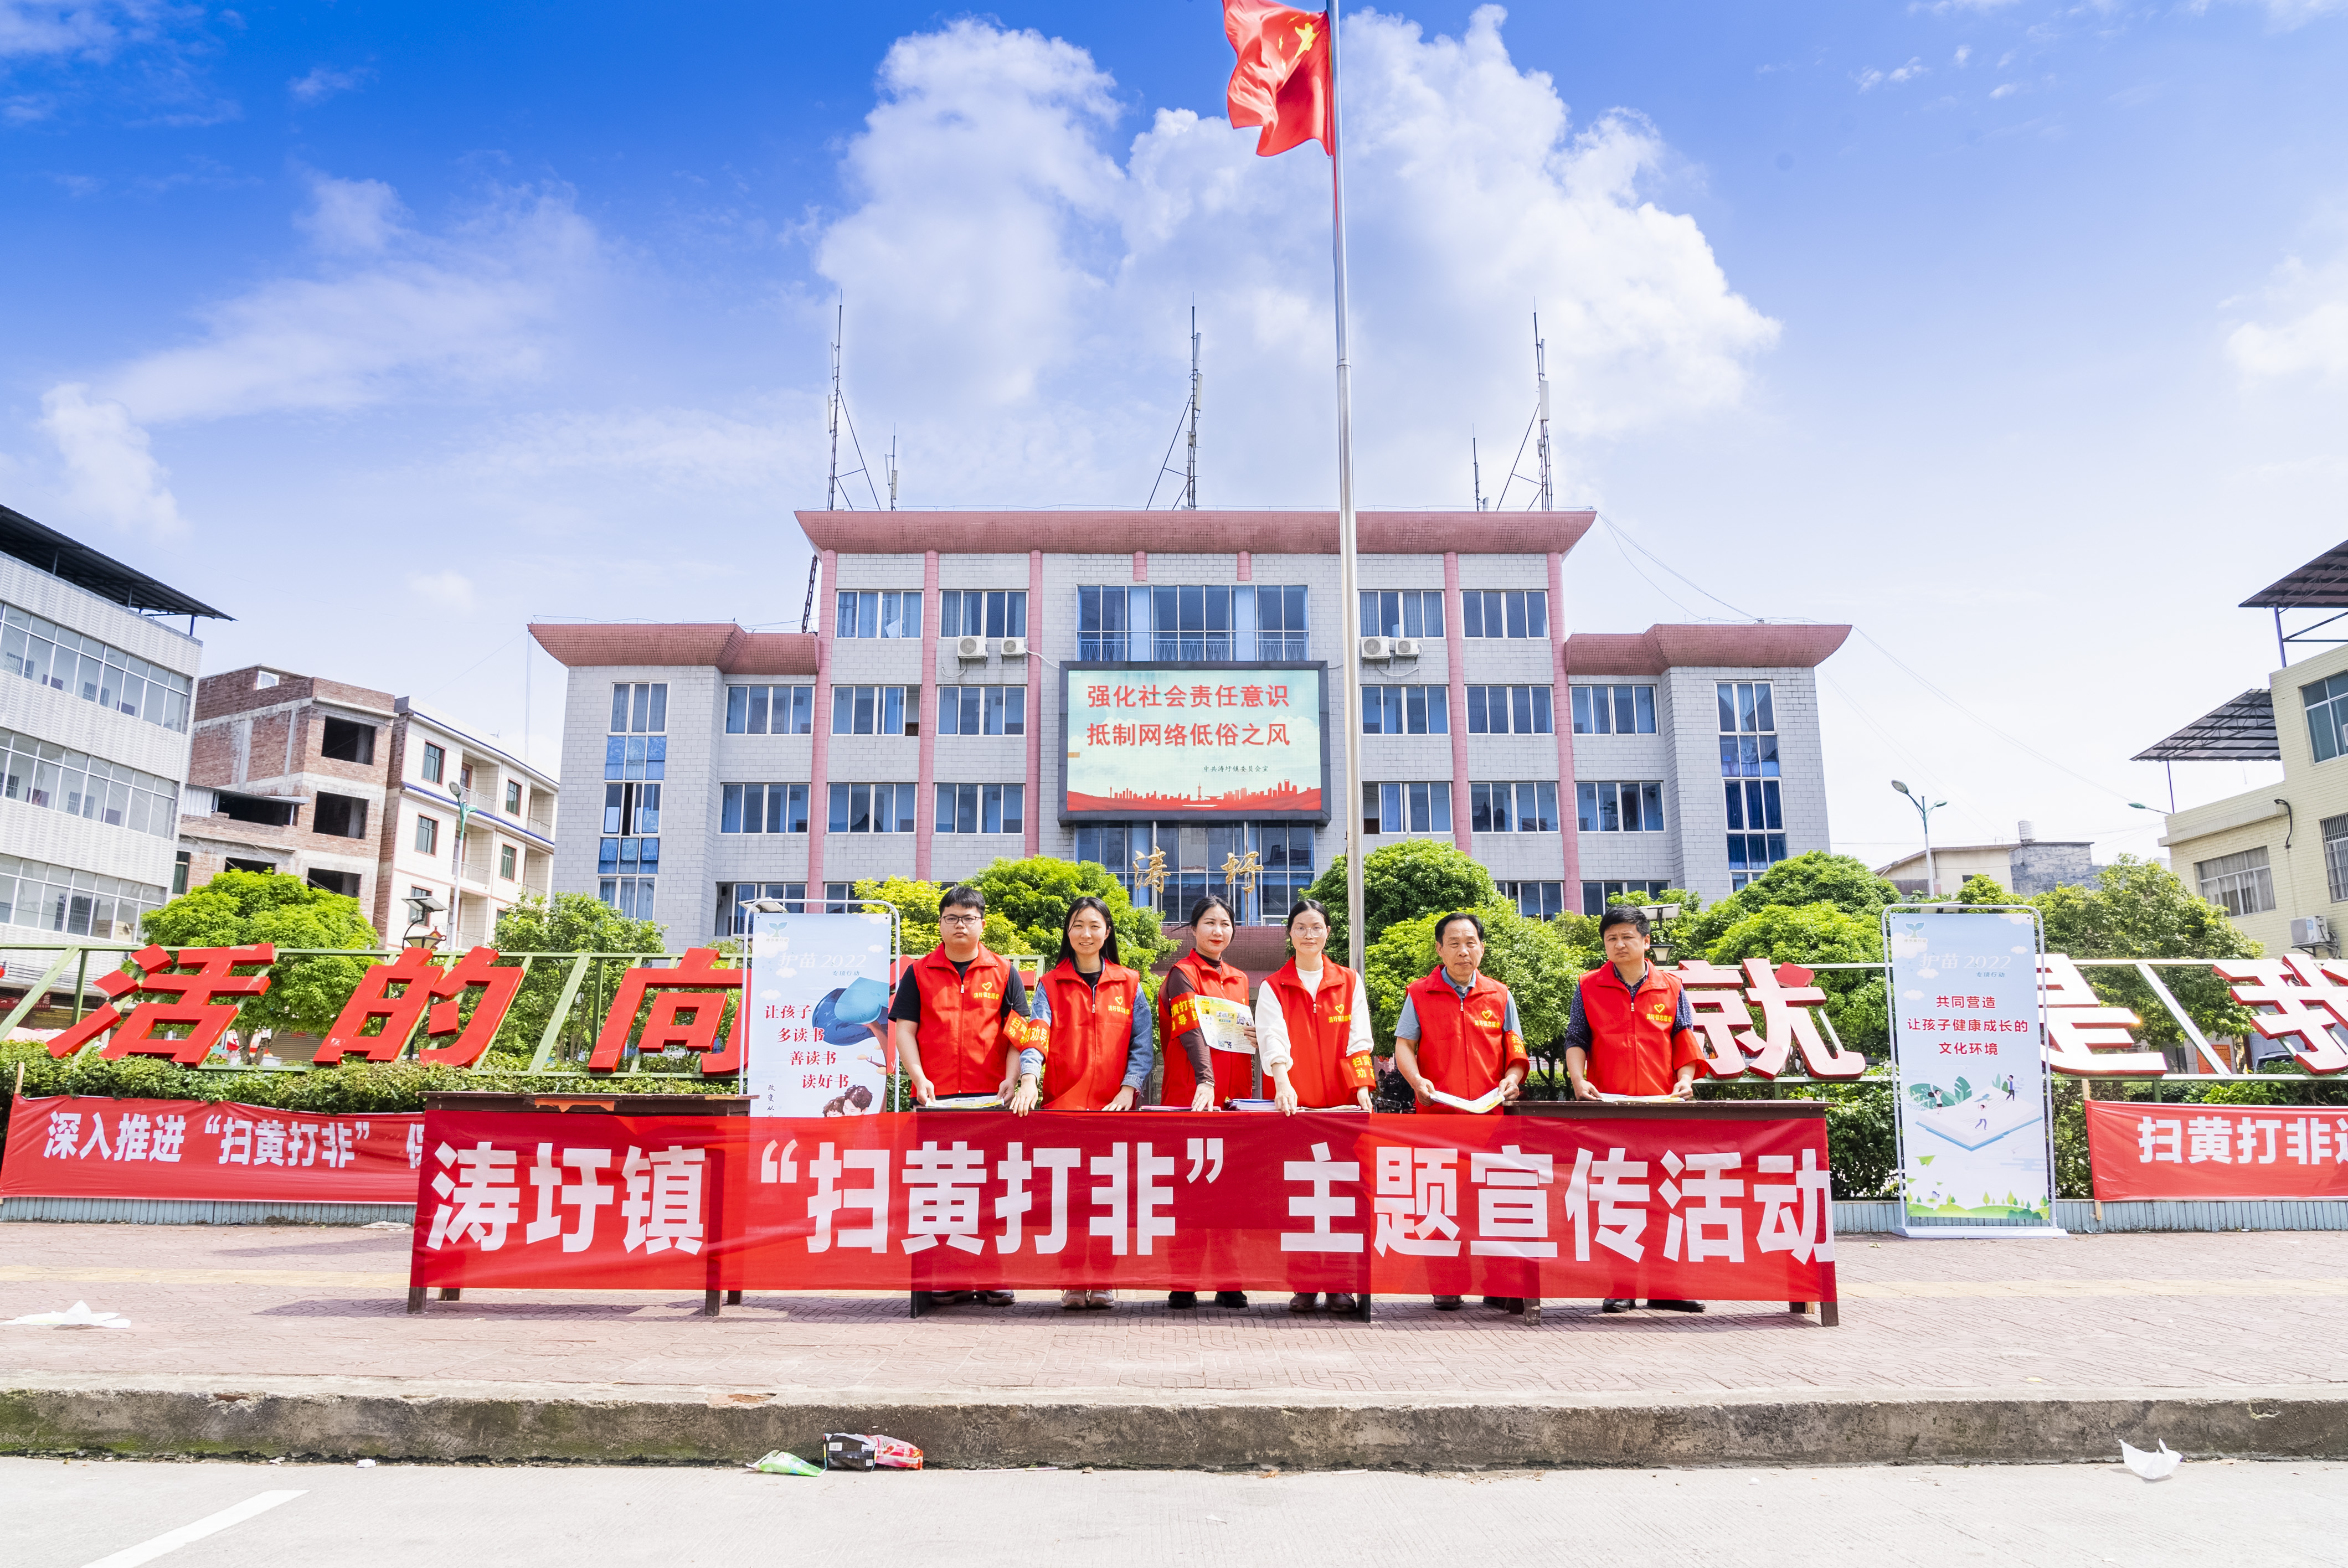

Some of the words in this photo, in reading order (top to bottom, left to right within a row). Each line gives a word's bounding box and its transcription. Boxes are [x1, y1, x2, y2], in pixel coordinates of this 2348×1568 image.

[1087, 684, 1290, 708] 强化社会责任意识
[1087, 723, 1290, 746] 抵制网络低俗之风
[1171, 998, 1195, 1018] 黄打非
[1936, 996, 1996, 1009] 共同营造
[764, 1005, 812, 1020] 让孩子
[1907, 1018, 2029, 1033] 让孩子健康成长的
[777, 1028, 825, 1043] 多读书
[1938, 1042, 1999, 1056] 文化环境
[790, 1051, 837, 1066] 善读书
[1352, 1055, 1372, 1067] 扫黄
[801, 1074, 849, 1089] 读好书
